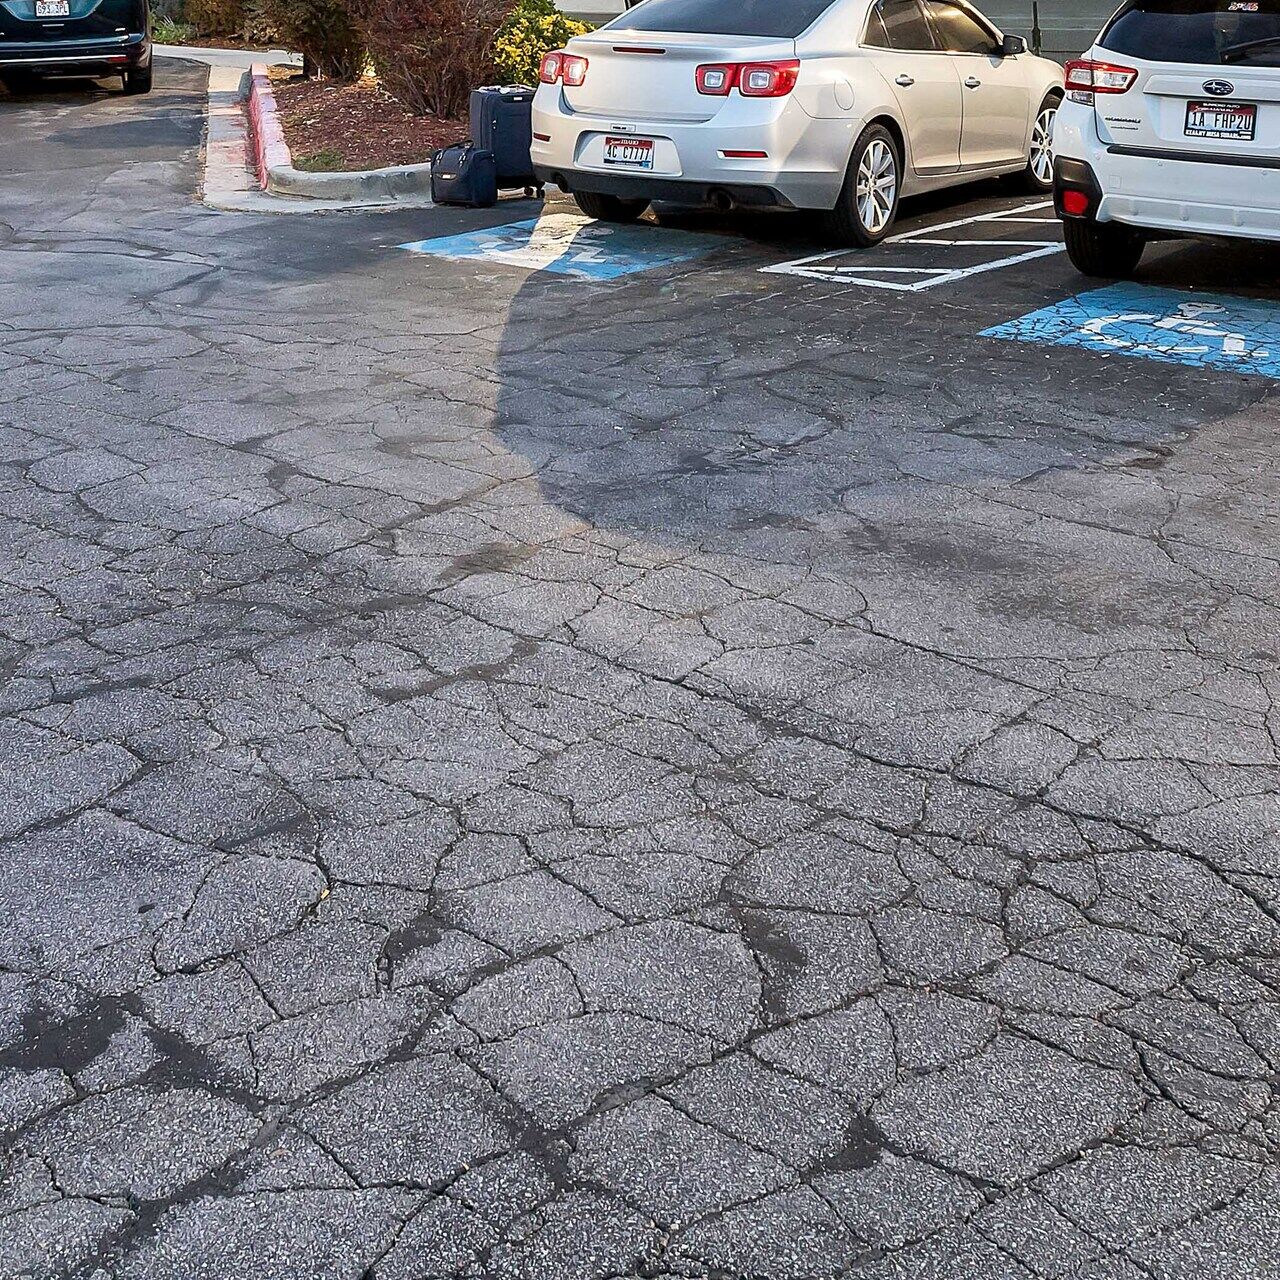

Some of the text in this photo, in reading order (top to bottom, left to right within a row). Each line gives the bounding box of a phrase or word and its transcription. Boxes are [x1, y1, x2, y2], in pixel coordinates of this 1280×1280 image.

[1191, 112, 1252, 130] 1A FHP2U
[607, 144, 650, 161] 4C C7777
